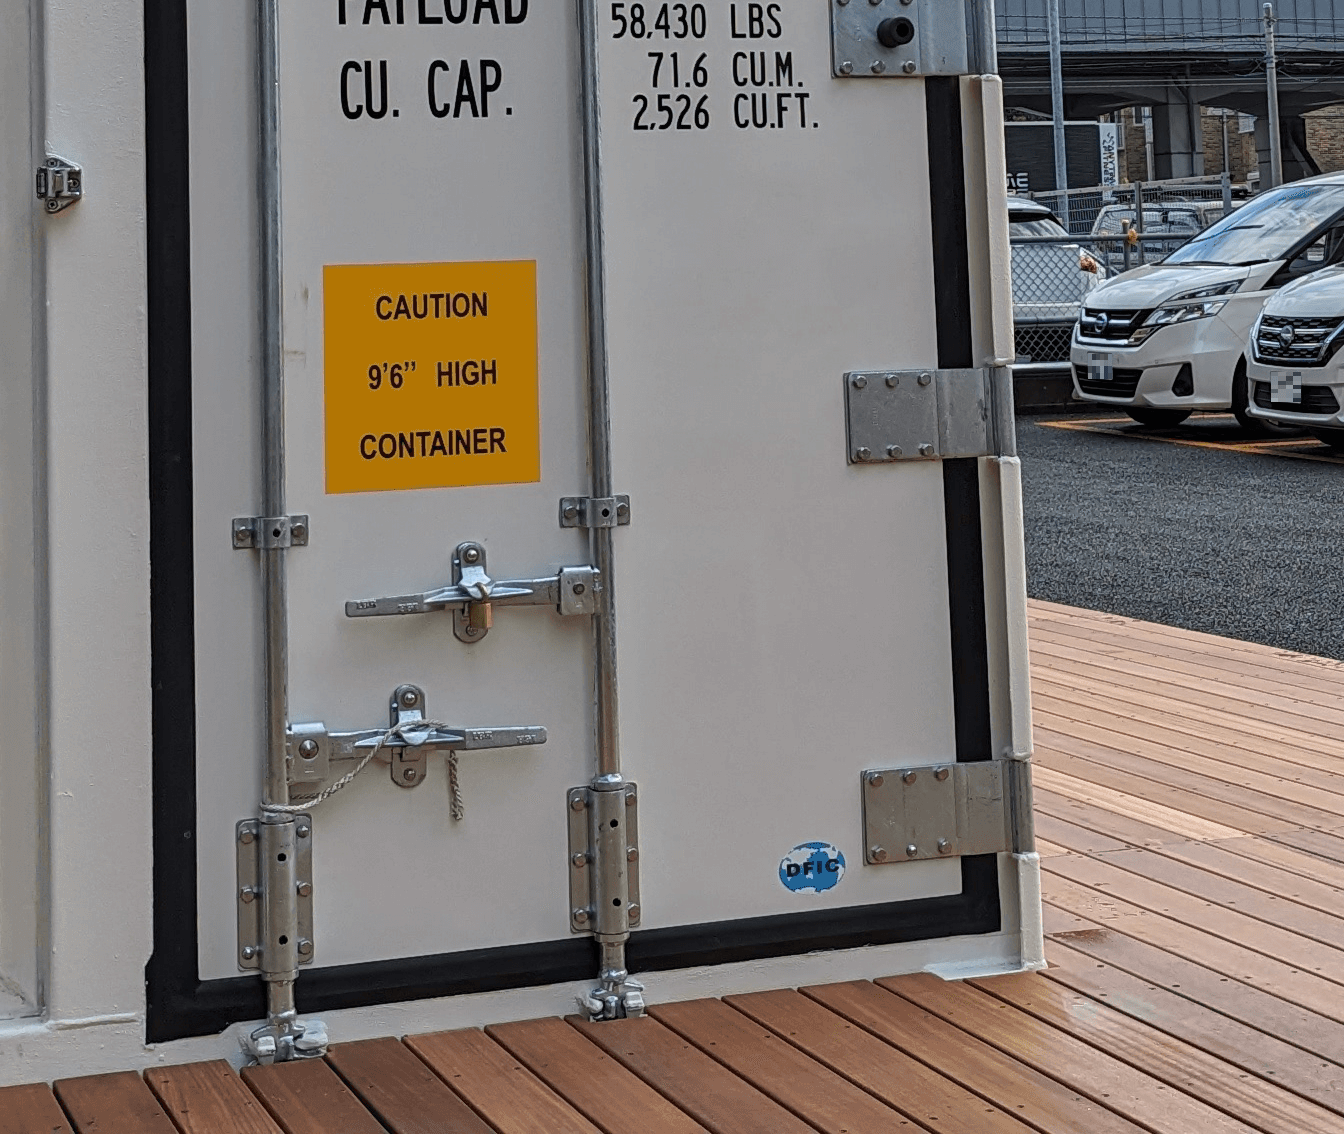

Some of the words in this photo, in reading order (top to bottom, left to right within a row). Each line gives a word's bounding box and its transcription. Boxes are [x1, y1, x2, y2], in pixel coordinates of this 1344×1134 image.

[612, 3, 706, 38] 58,430
[731, 3, 781, 38] LBS
[648, 52, 707, 88] 71.6
[733, 52, 803, 87] CU.M.
[341, 60, 399, 119] CU.
[428, 60, 512, 118] CAP.
[633, 94, 709, 130] 2,526
[734, 93, 818, 128] CU.FT.
[376, 292, 487, 320] CAUTION
[438, 360, 496, 387] HIGH
[360, 428, 507, 459] CONTAINER
